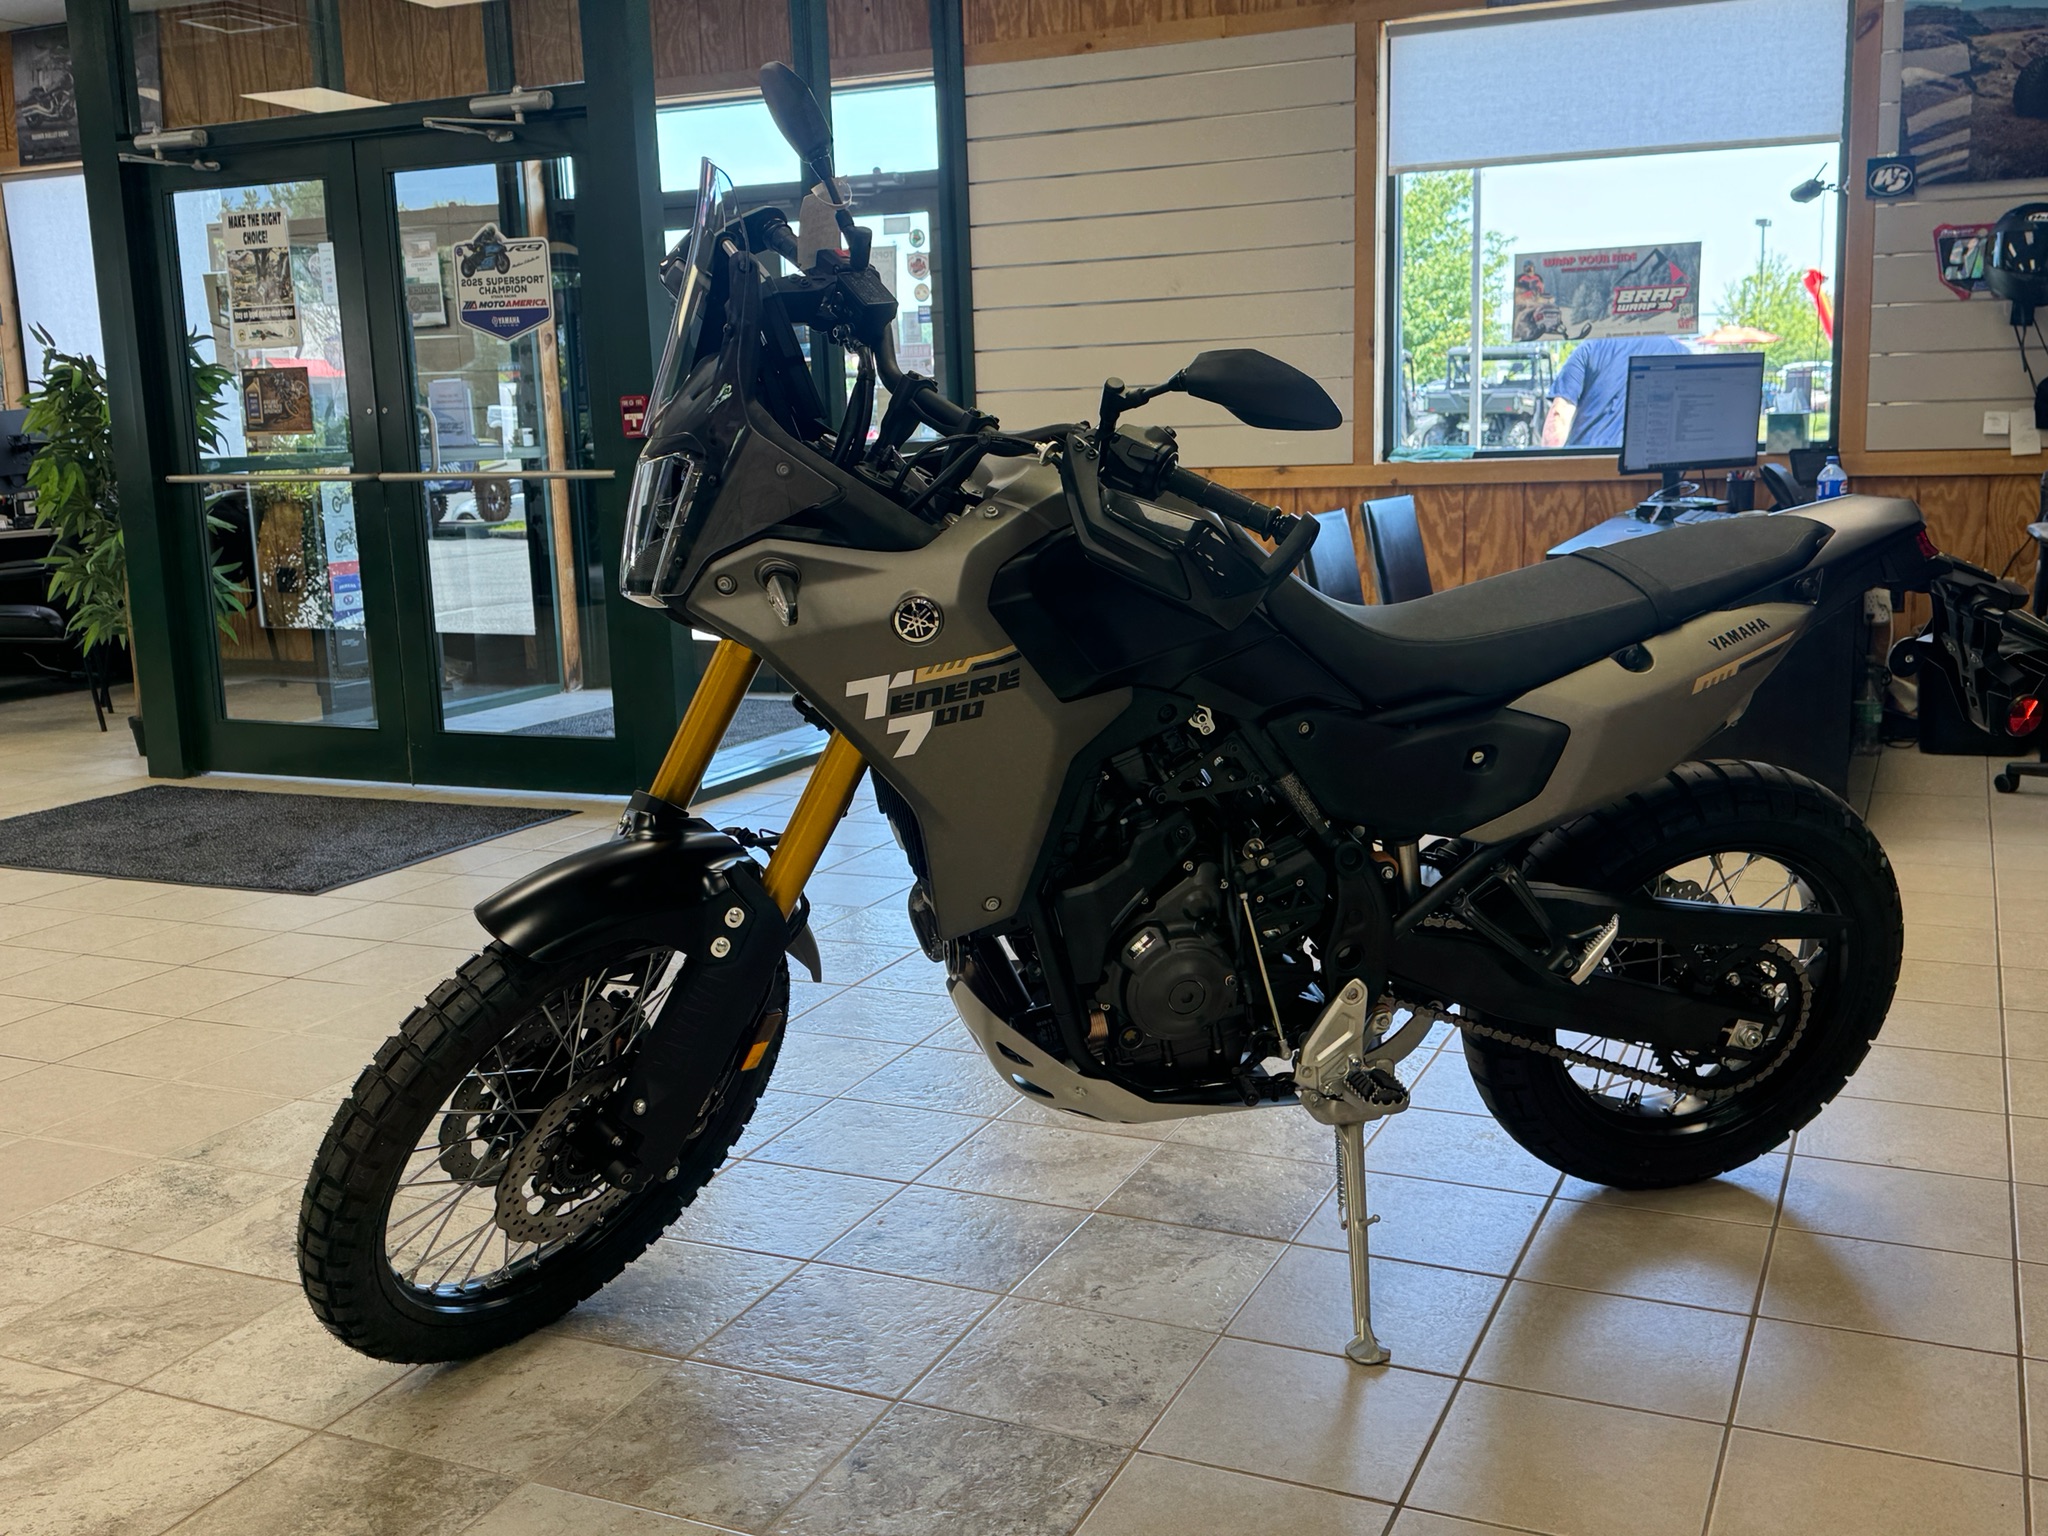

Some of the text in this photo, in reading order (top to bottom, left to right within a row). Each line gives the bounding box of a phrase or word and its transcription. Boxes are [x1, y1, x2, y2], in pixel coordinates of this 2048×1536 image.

[228, 211, 281, 229] MAKE THE RIGHT
[242, 230, 268, 245] CHOICE!
[1543, 252, 1638, 268] WRAP YOUR RIDE
[461, 275, 544, 287] 2025 SUPERSPORT
[478, 285, 528, 295] CHAMPION
[1617, 286, 1688, 304] BRAP
[479, 299, 547, 309] MOTOAMERICA
[1616, 302, 1658, 312] WRAP
[497, 316, 520, 325] YAMAHA
[1707, 617, 1771, 651] YAMAHA
[886, 700, 985, 759] 700
